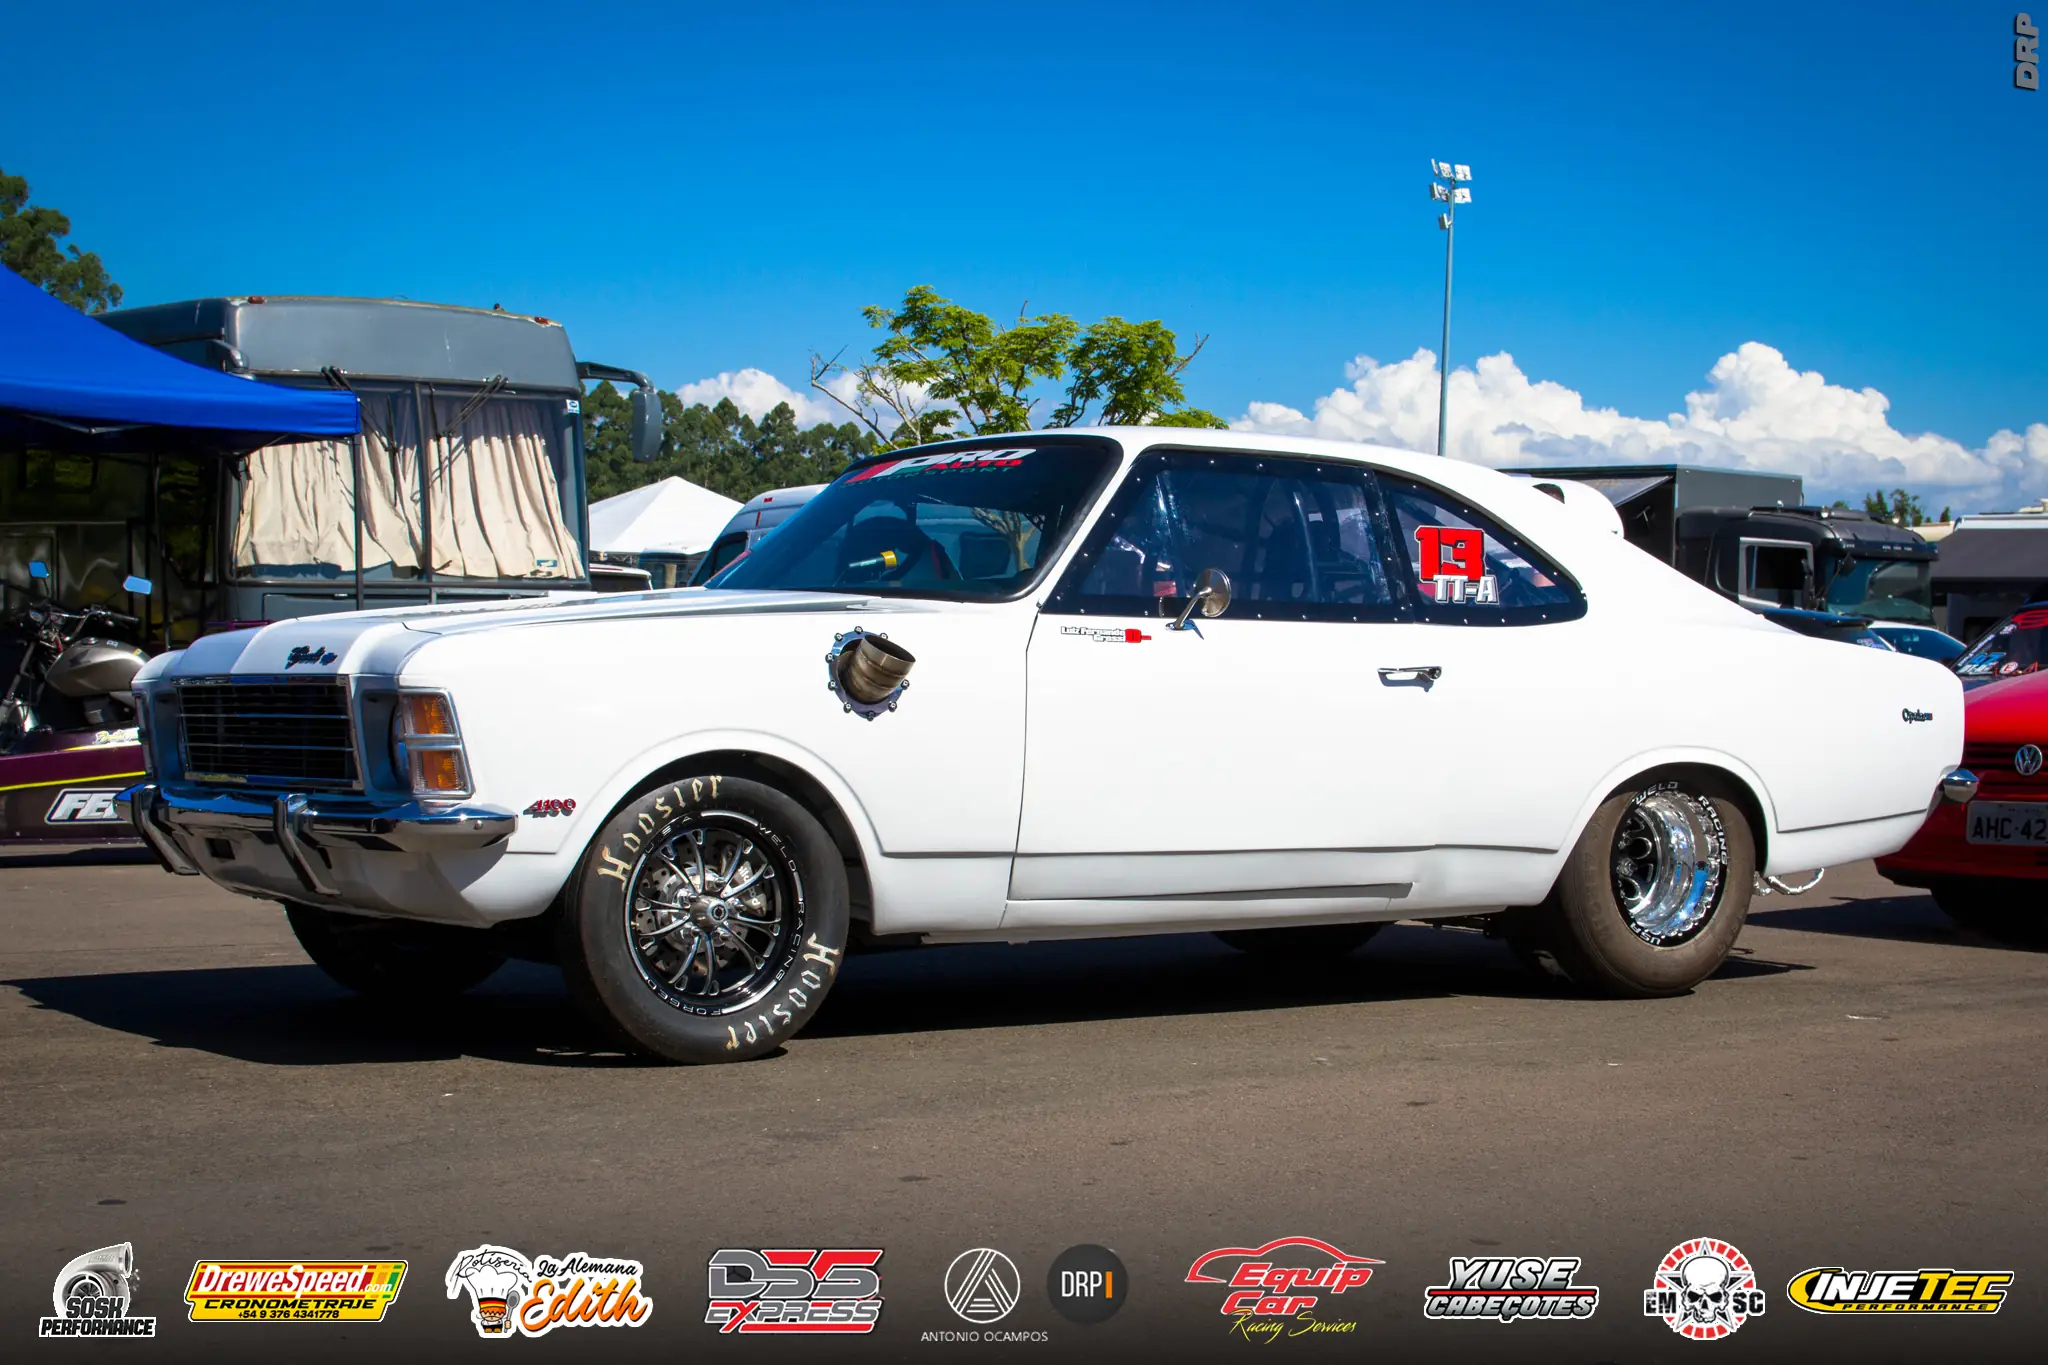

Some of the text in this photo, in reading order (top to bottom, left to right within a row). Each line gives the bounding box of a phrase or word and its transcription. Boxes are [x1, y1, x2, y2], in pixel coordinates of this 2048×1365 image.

[923, 459, 1023, 471] AUTO
[1414, 526, 1486, 583] 13
[1432, 575, 1498, 604] TT-A
[51, 793, 119, 819] FE
[523, 798, 576, 818] 4100
[1635, 781, 1728, 865] WELD RACING
[758, 821, 806, 982] WELD RACING
[1629, 922, 1661, 946] USA
[646, 978, 722, 1016] FORGED
